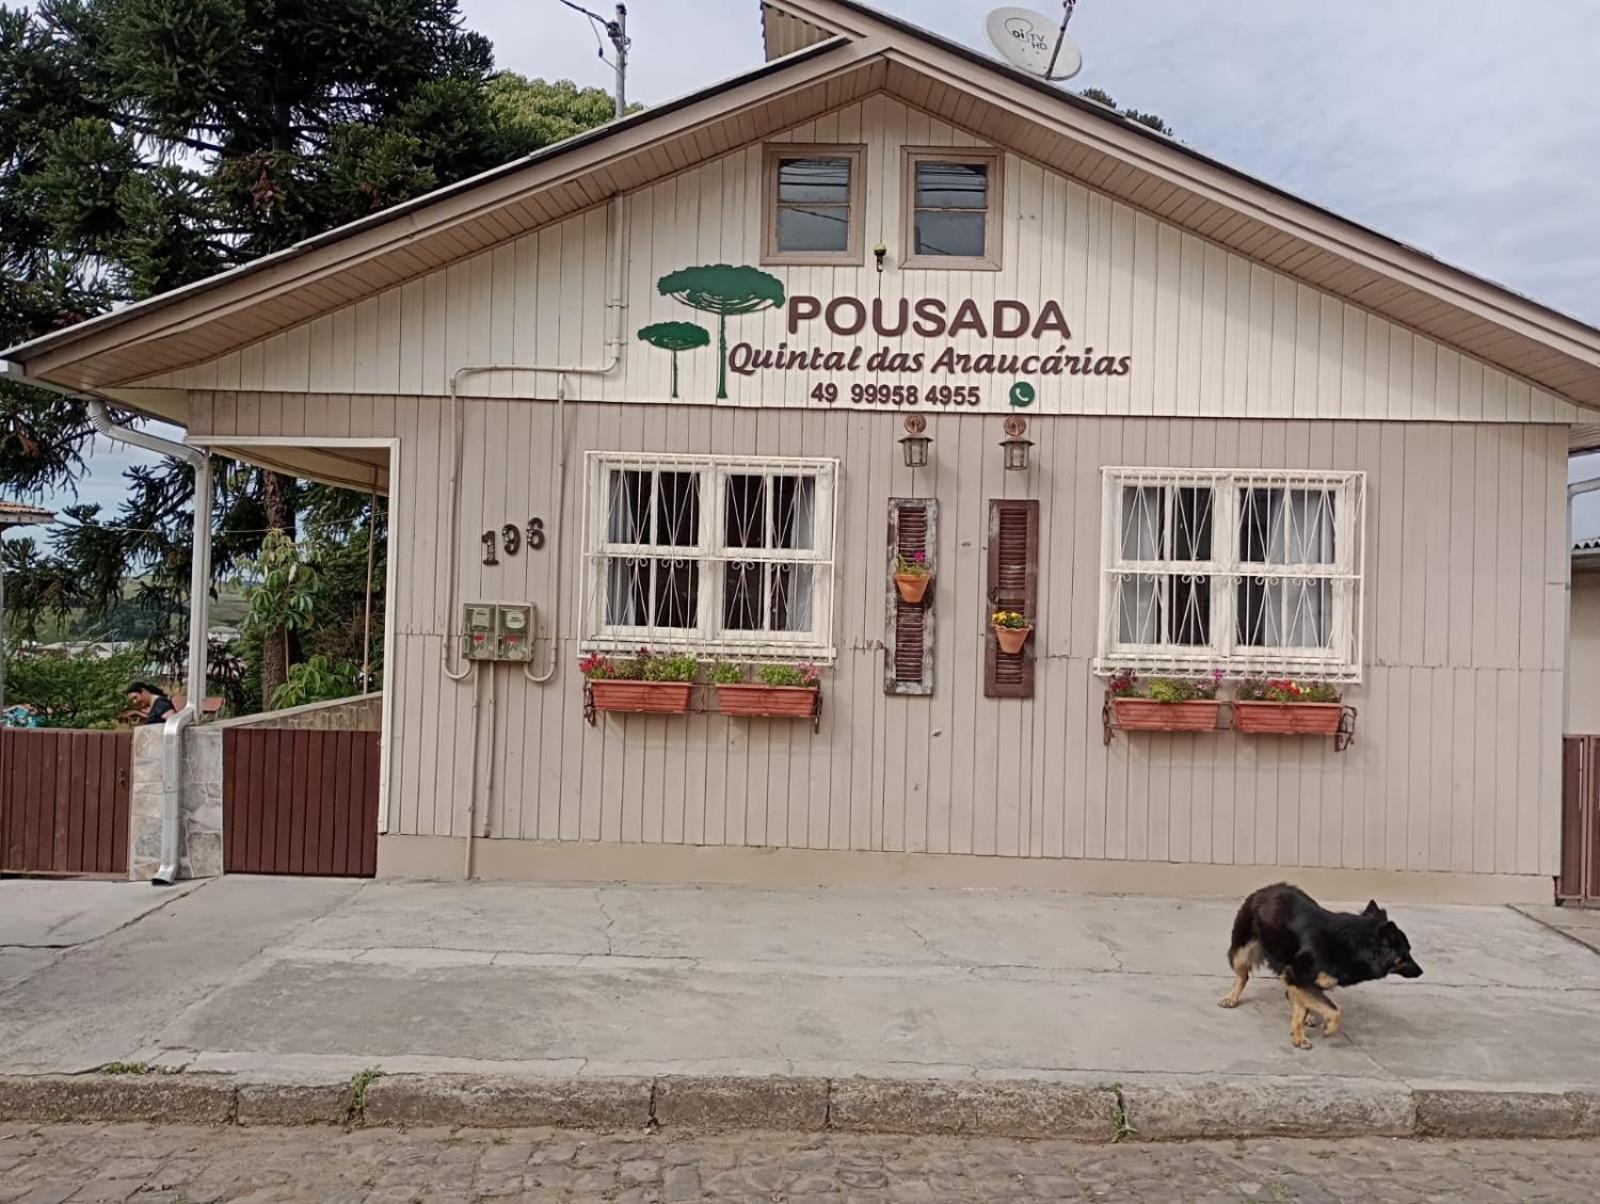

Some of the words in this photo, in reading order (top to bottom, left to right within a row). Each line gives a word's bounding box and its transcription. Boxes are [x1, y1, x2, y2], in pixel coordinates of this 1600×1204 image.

[1030, 33, 1044, 42] TV
[1032, 42, 1047, 50] HD
[788, 296, 1071, 339] POUSADA
[729, 342, 863, 376] Quintal
[866, 346, 924, 373] das
[930, 344, 1130, 376] Araucárias
[811, 382, 838, 402] 49
[850, 384, 919, 406] 99958
[925, 385, 981, 406] 4955
[482, 517, 545, 566] 196
